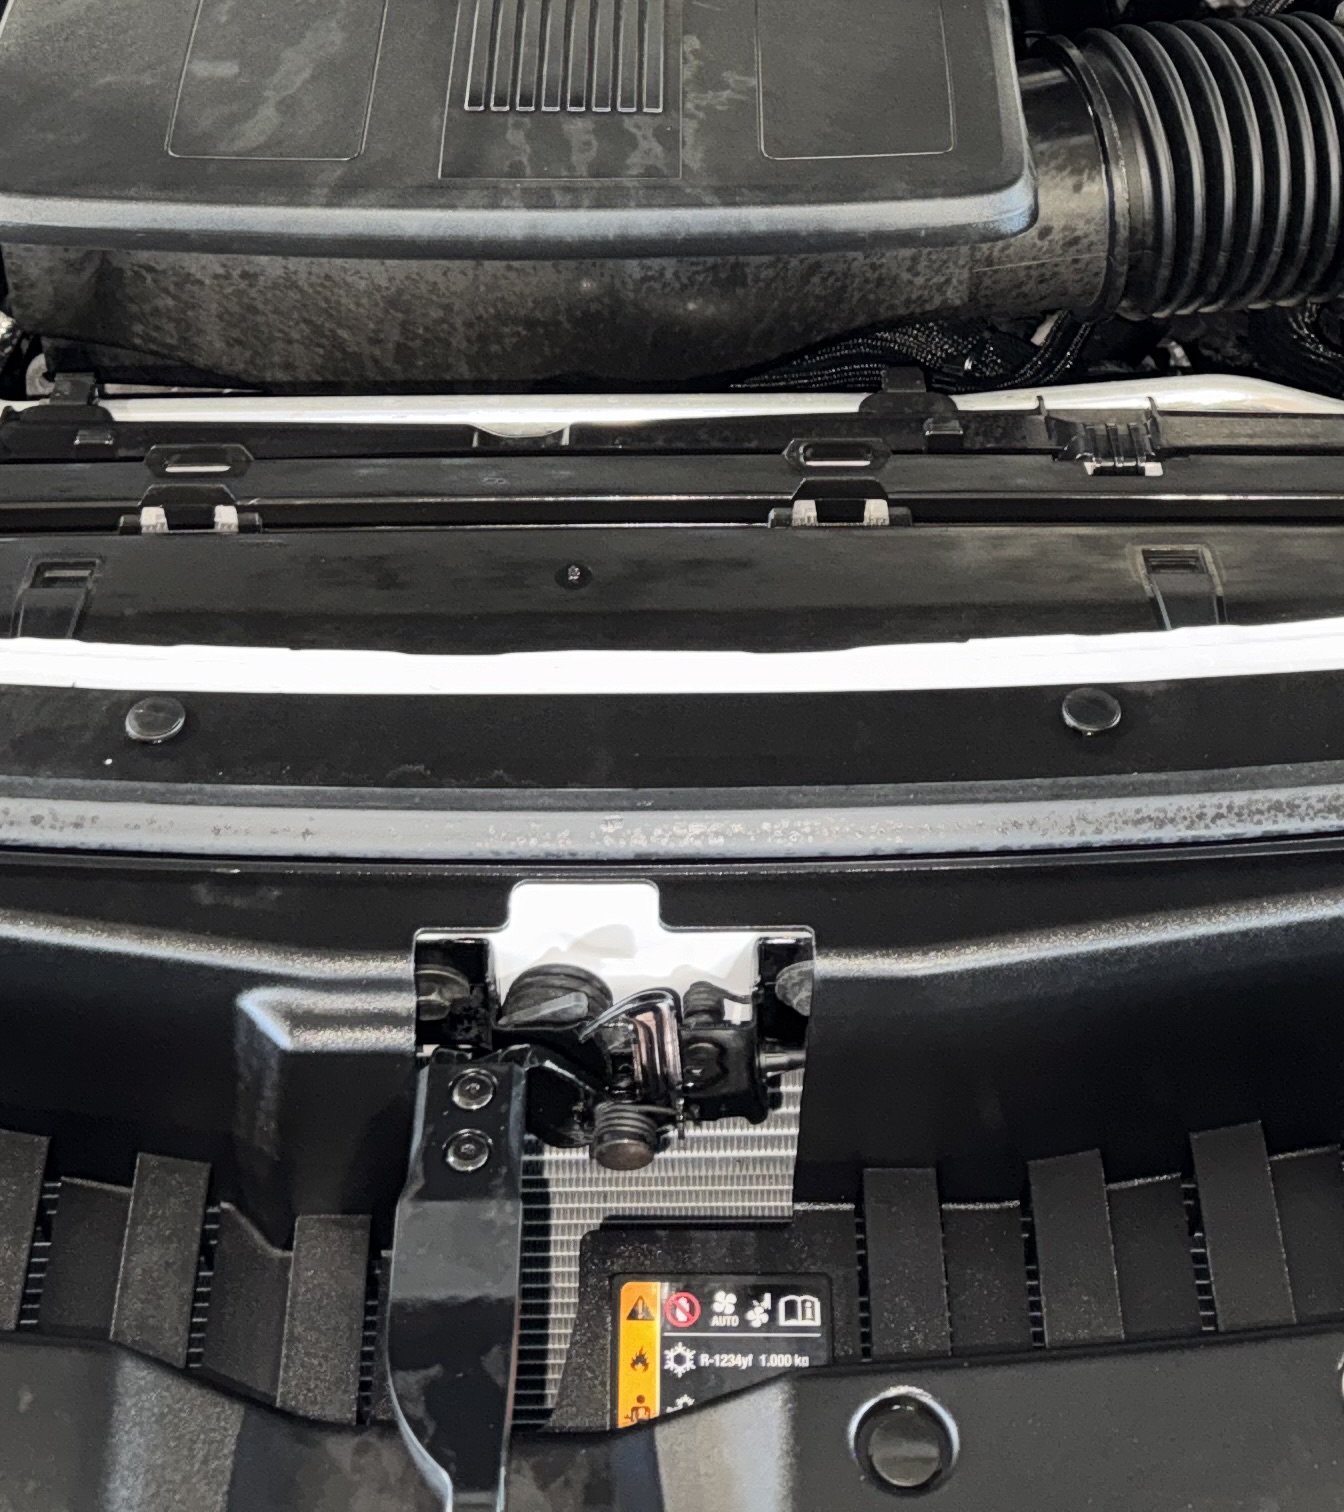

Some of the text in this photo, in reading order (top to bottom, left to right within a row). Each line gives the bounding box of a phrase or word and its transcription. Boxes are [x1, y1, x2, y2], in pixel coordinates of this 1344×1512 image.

[710, 1315, 739, 1327] AUTO
[700, 1353, 753, 1369] R-1234yf
[759, 1353, 792, 1367] 1.000
